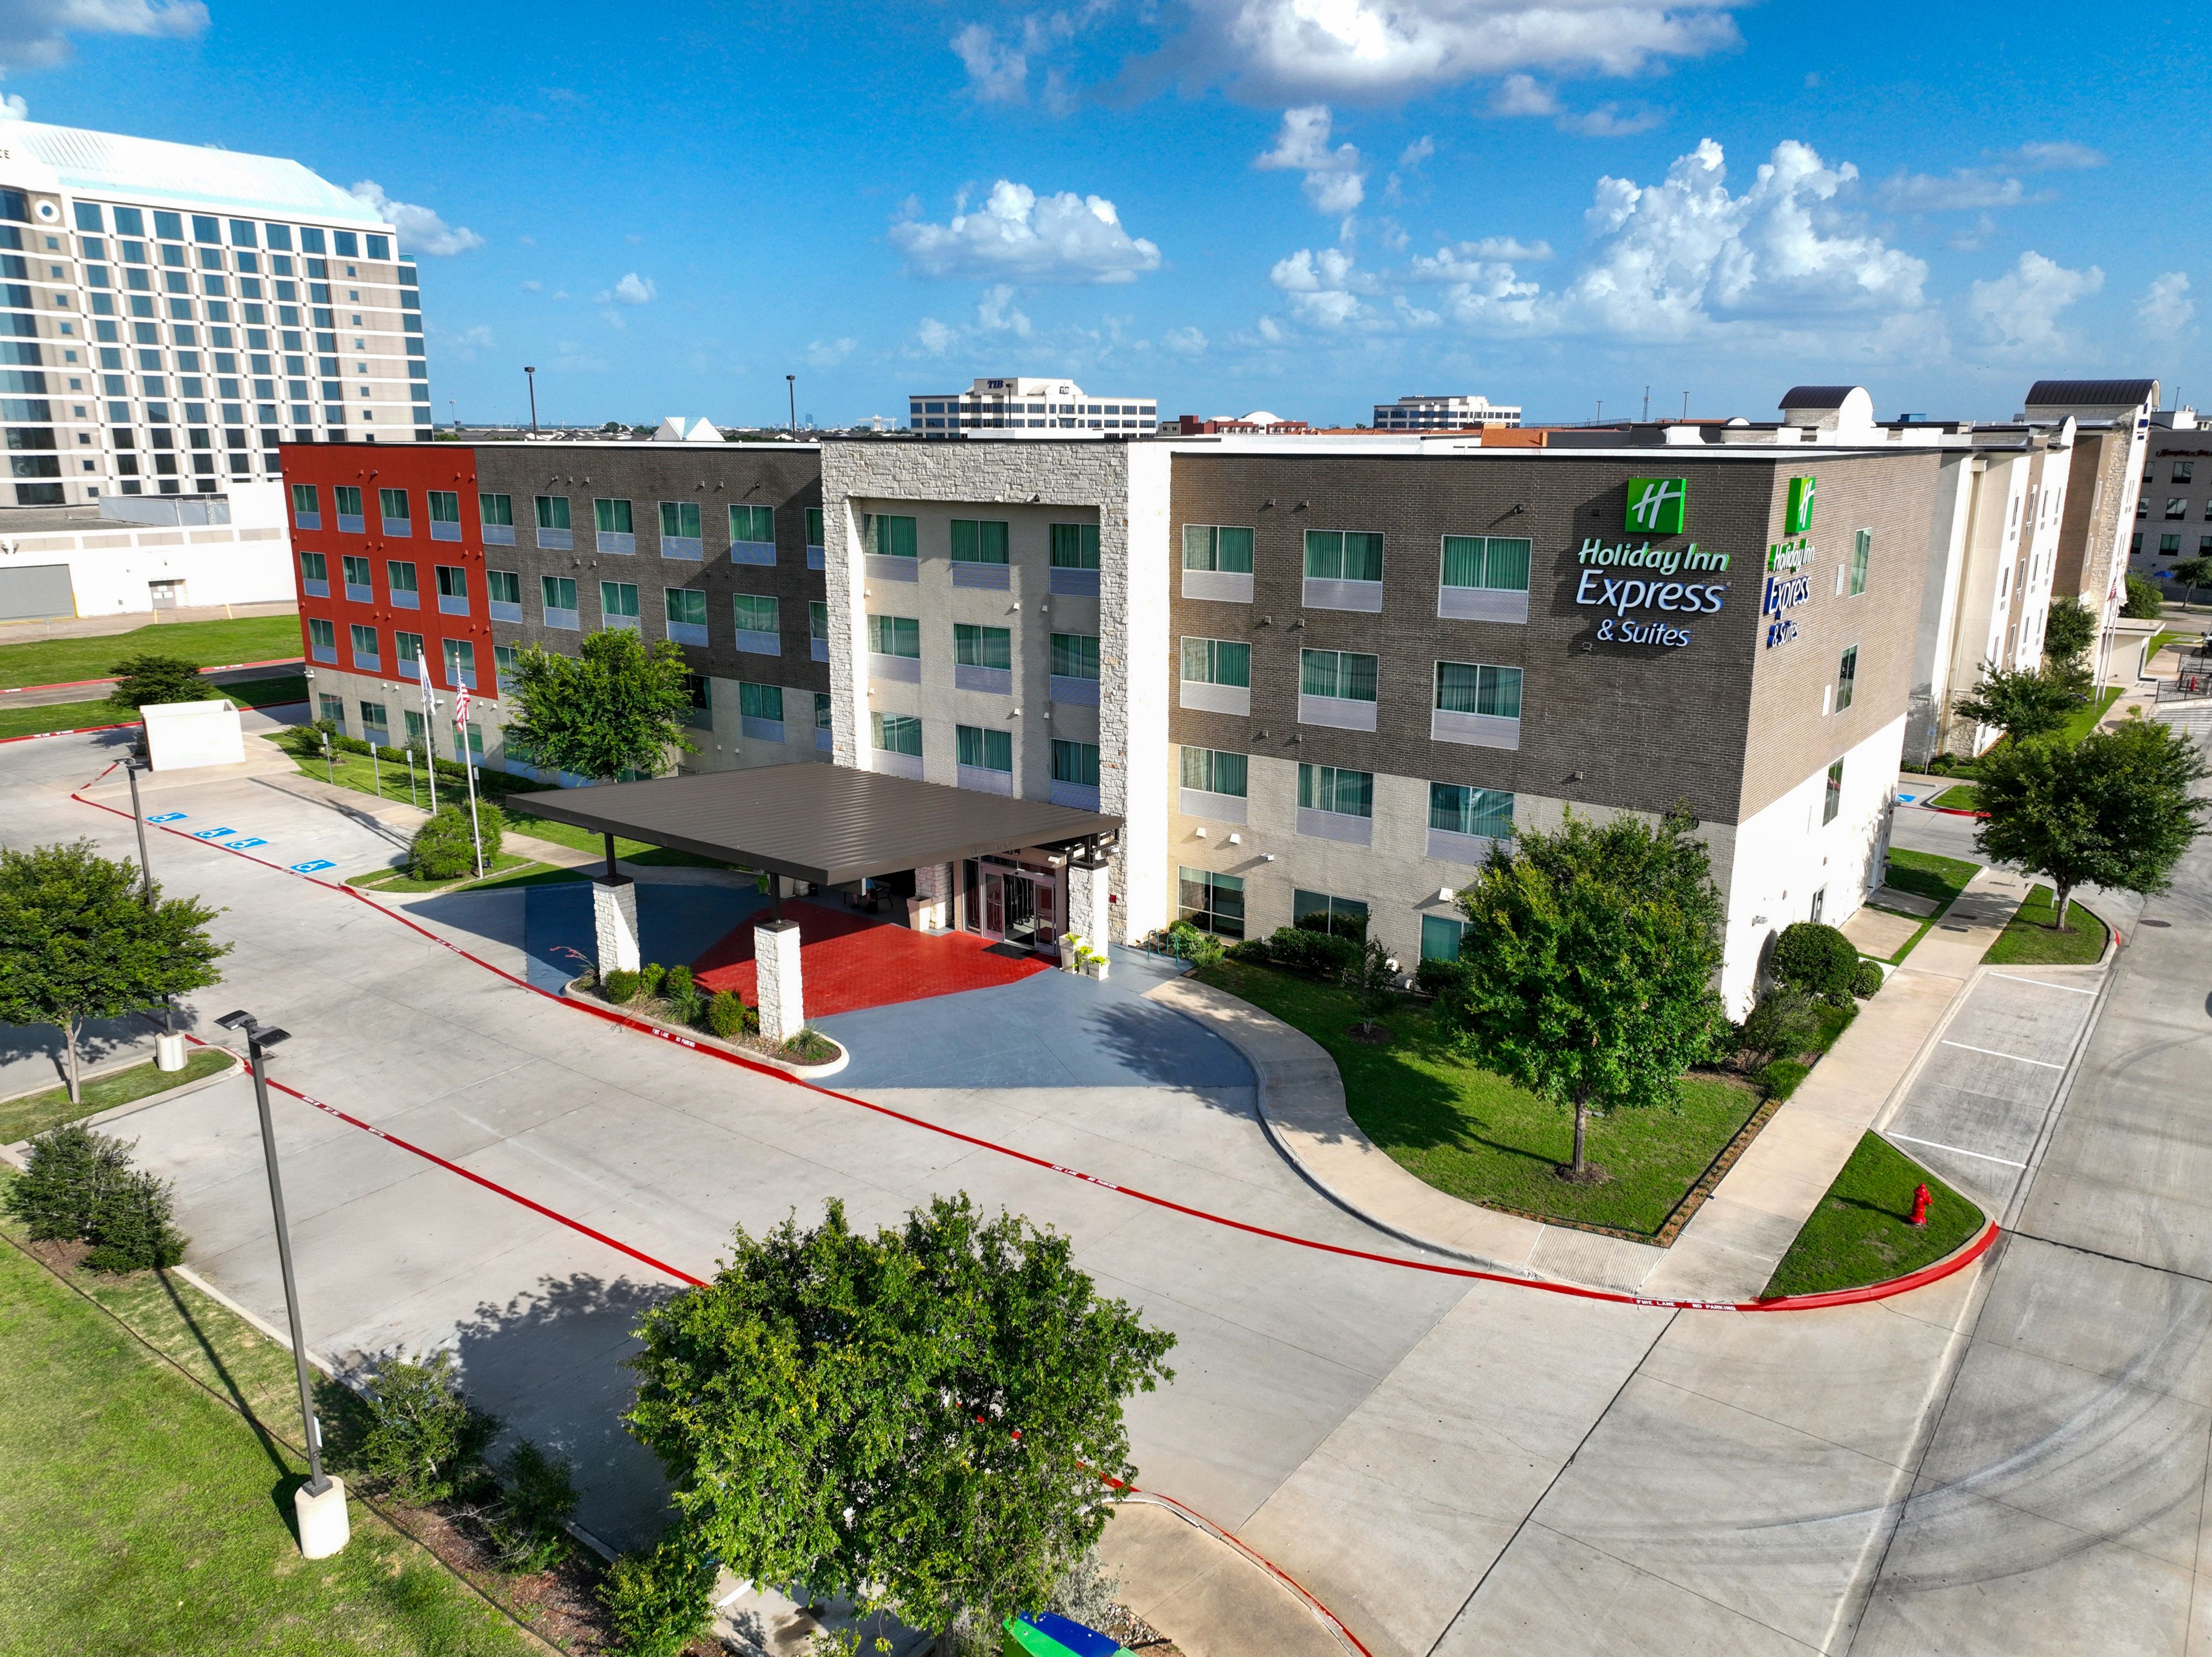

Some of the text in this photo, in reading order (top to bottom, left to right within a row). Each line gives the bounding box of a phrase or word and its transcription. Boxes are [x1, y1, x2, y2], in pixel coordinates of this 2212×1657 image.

[987, 380, 1004, 389] TIB
[1578, 538, 1730, 576] Holiday Inn
[1773, 539, 1815, 573] Holiday Inn
[1576, 569, 1726, 617] Express
[1768, 576, 1812, 620] Express
[1597, 619, 1692, 647] & Suites
[1772, 622, 1799, 648] & Suites
